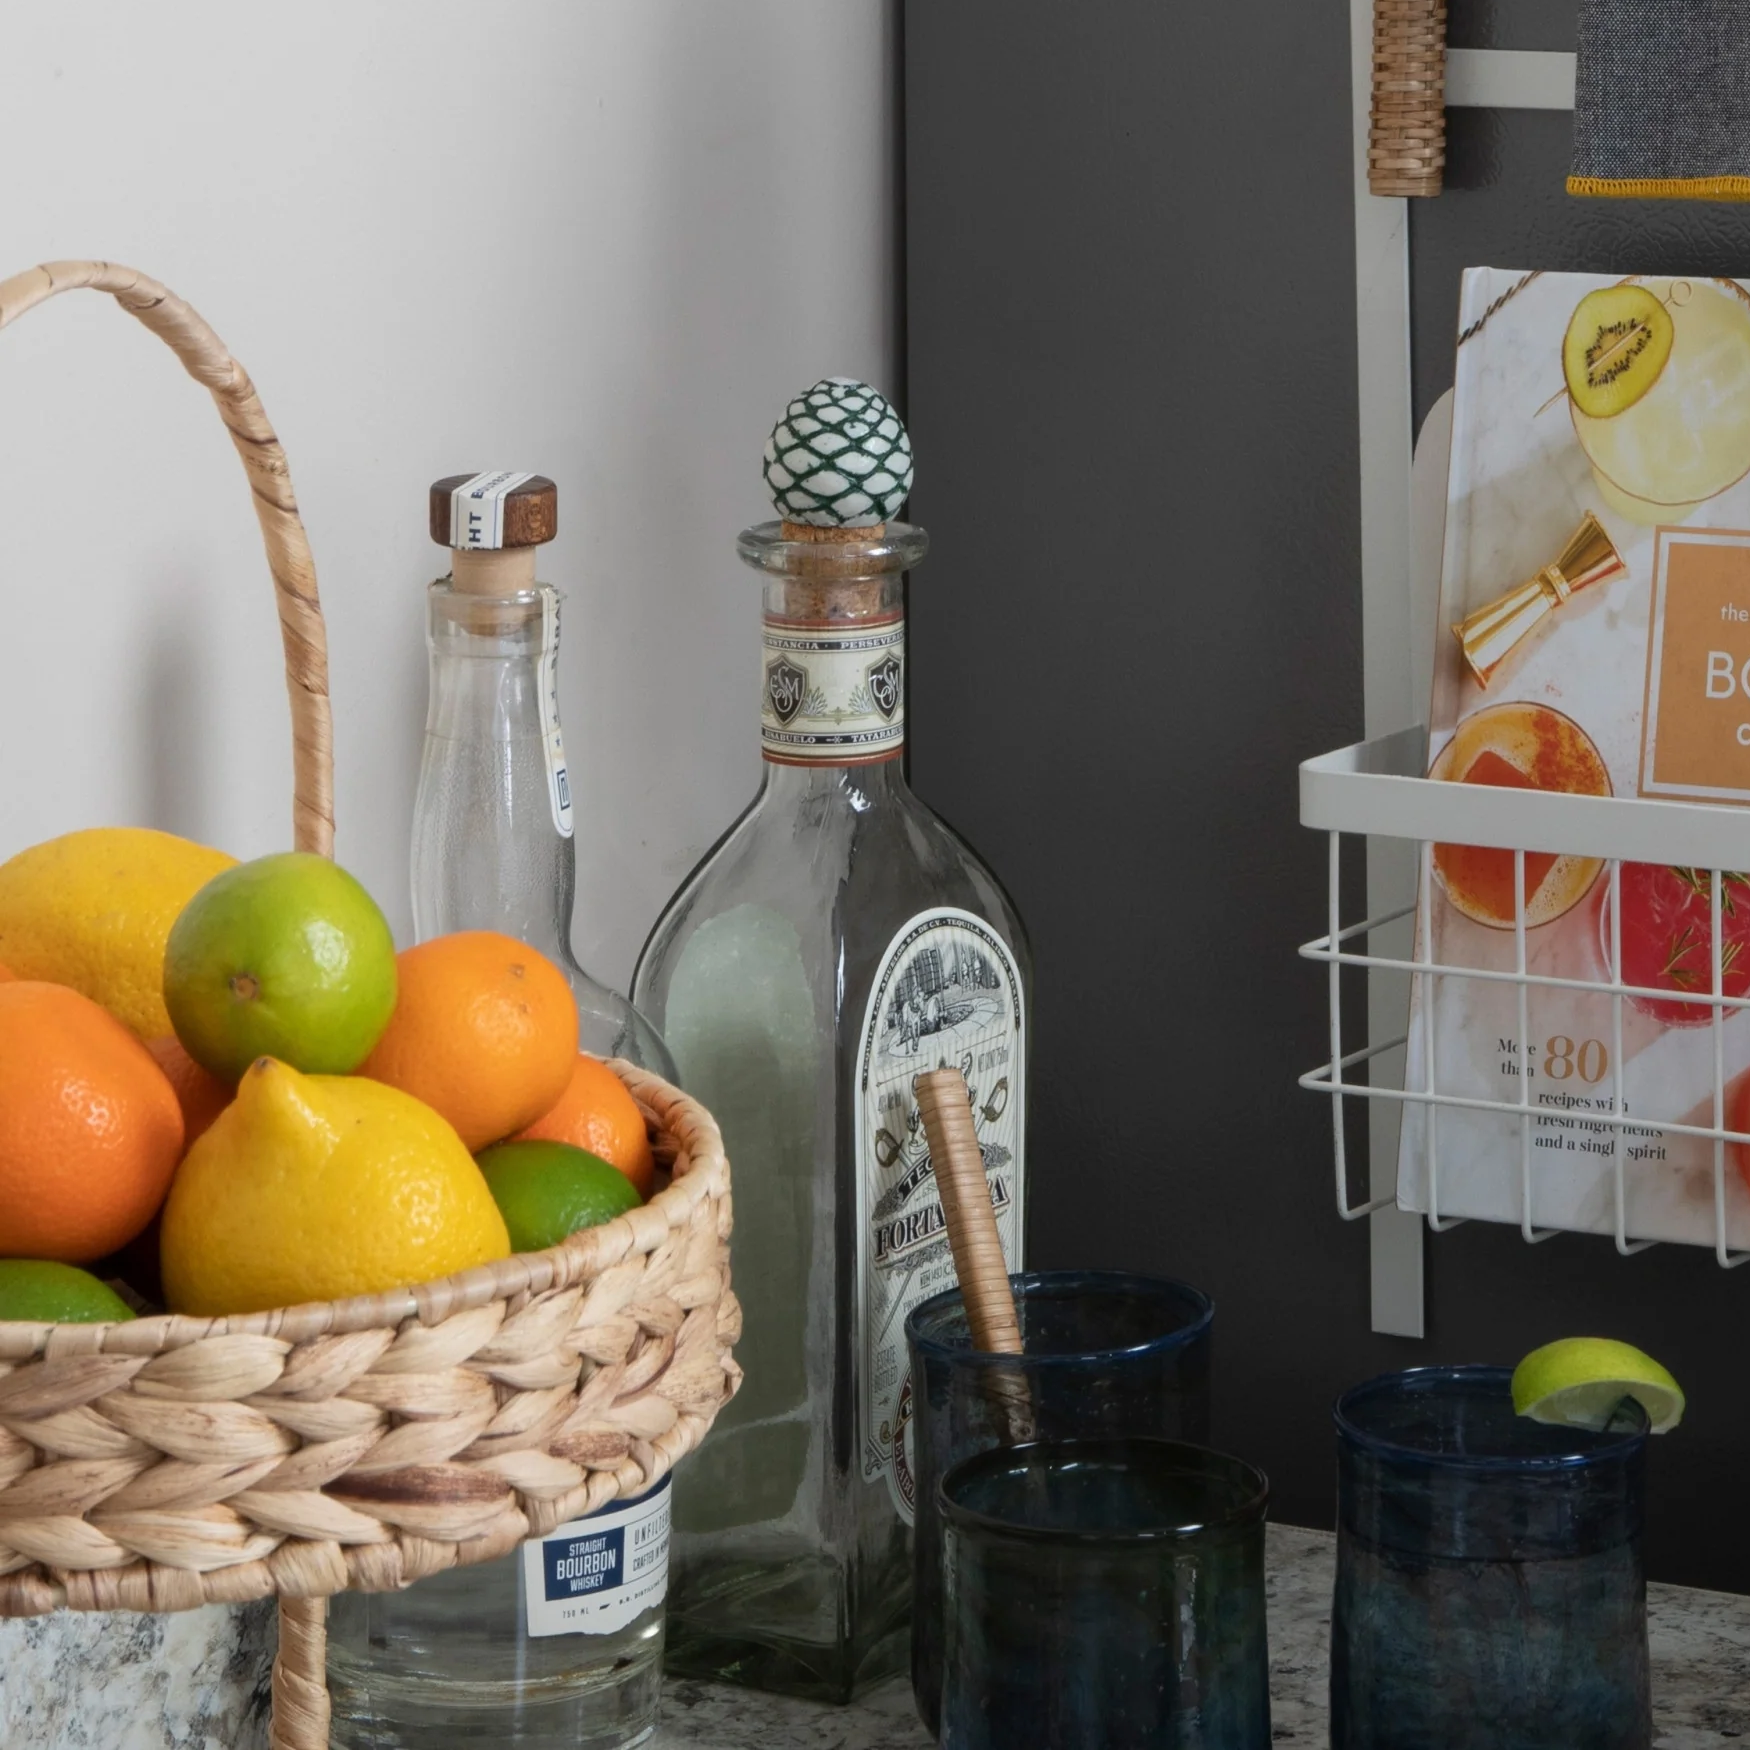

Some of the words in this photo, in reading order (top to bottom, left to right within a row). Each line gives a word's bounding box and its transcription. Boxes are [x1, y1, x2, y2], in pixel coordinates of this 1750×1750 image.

[1721, 602, 1749, 622] the
[765, 637, 820, 650] NSTANCIA
[918, 923, 929, 934] DE
[1497, 1037, 1536, 1056] Moe
[1544, 1035, 1608, 1083] 80
[1538, 1092, 1591, 1110] recipes
[1596, 1096, 1628, 1112] wih
[1579, 1118, 1663, 1138] ingreients
[1535, 1134, 1563, 1150] and
[1567, 1141, 1575, 1151] a
[1579, 1138, 1615, 1157] singl
[1627, 1144, 1667, 1161] spirit
[875, 1175, 1010, 1261] FORTAA
[568, 1537, 607, 1557] STRAIGHT
[556, 1548, 617, 1580] BOURBON
[633, 1550, 654, 1572] CRAFTED
[570, 1573, 604, 1592] WHISKEY
